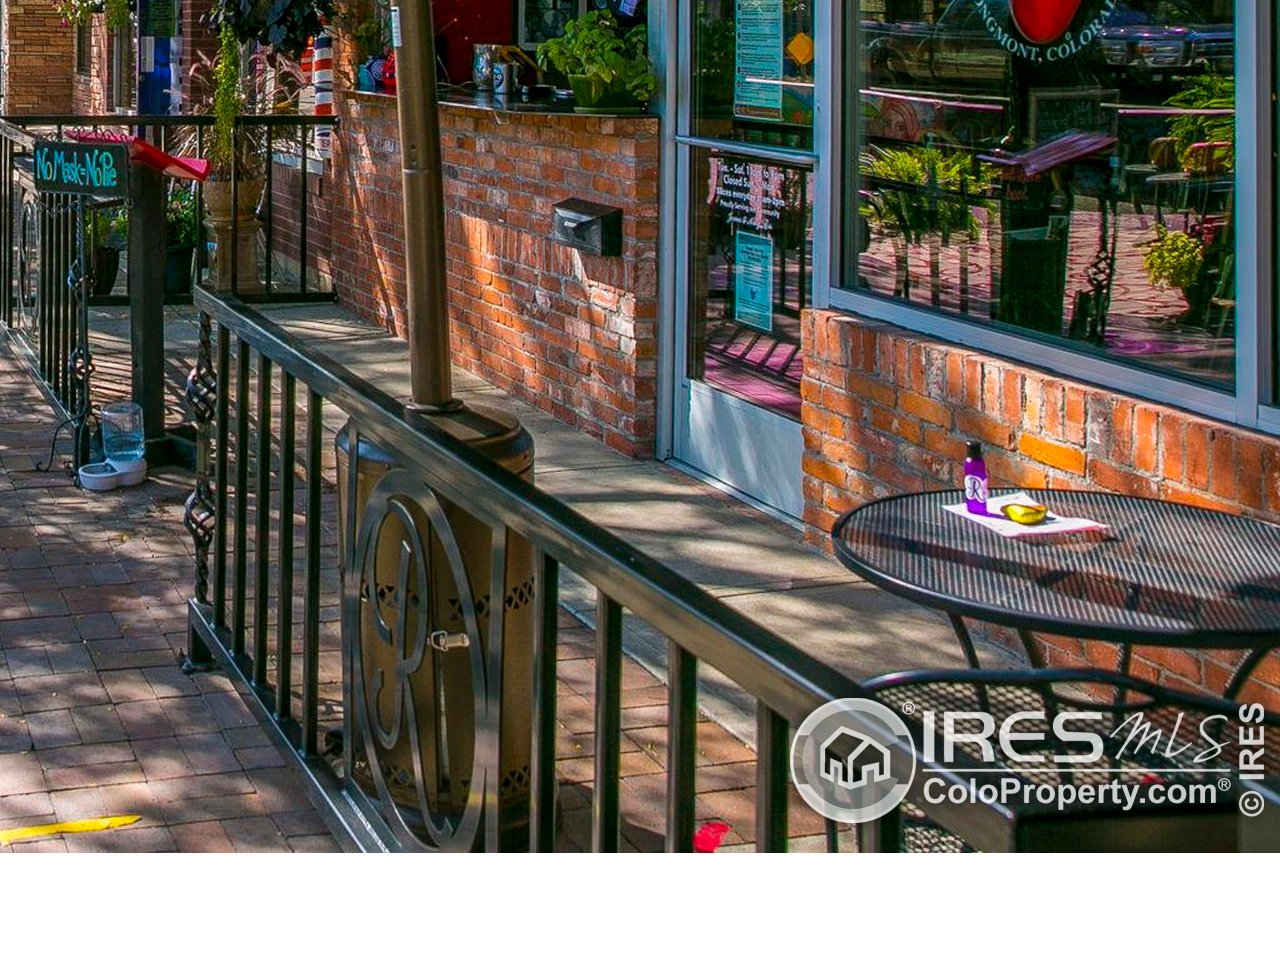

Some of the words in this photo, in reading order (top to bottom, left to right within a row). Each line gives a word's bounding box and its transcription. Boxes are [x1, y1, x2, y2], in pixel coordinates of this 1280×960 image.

[36, 147, 53, 181] No
[100, 151, 117, 187] Pie
[723, 175, 742, 187] Closed
